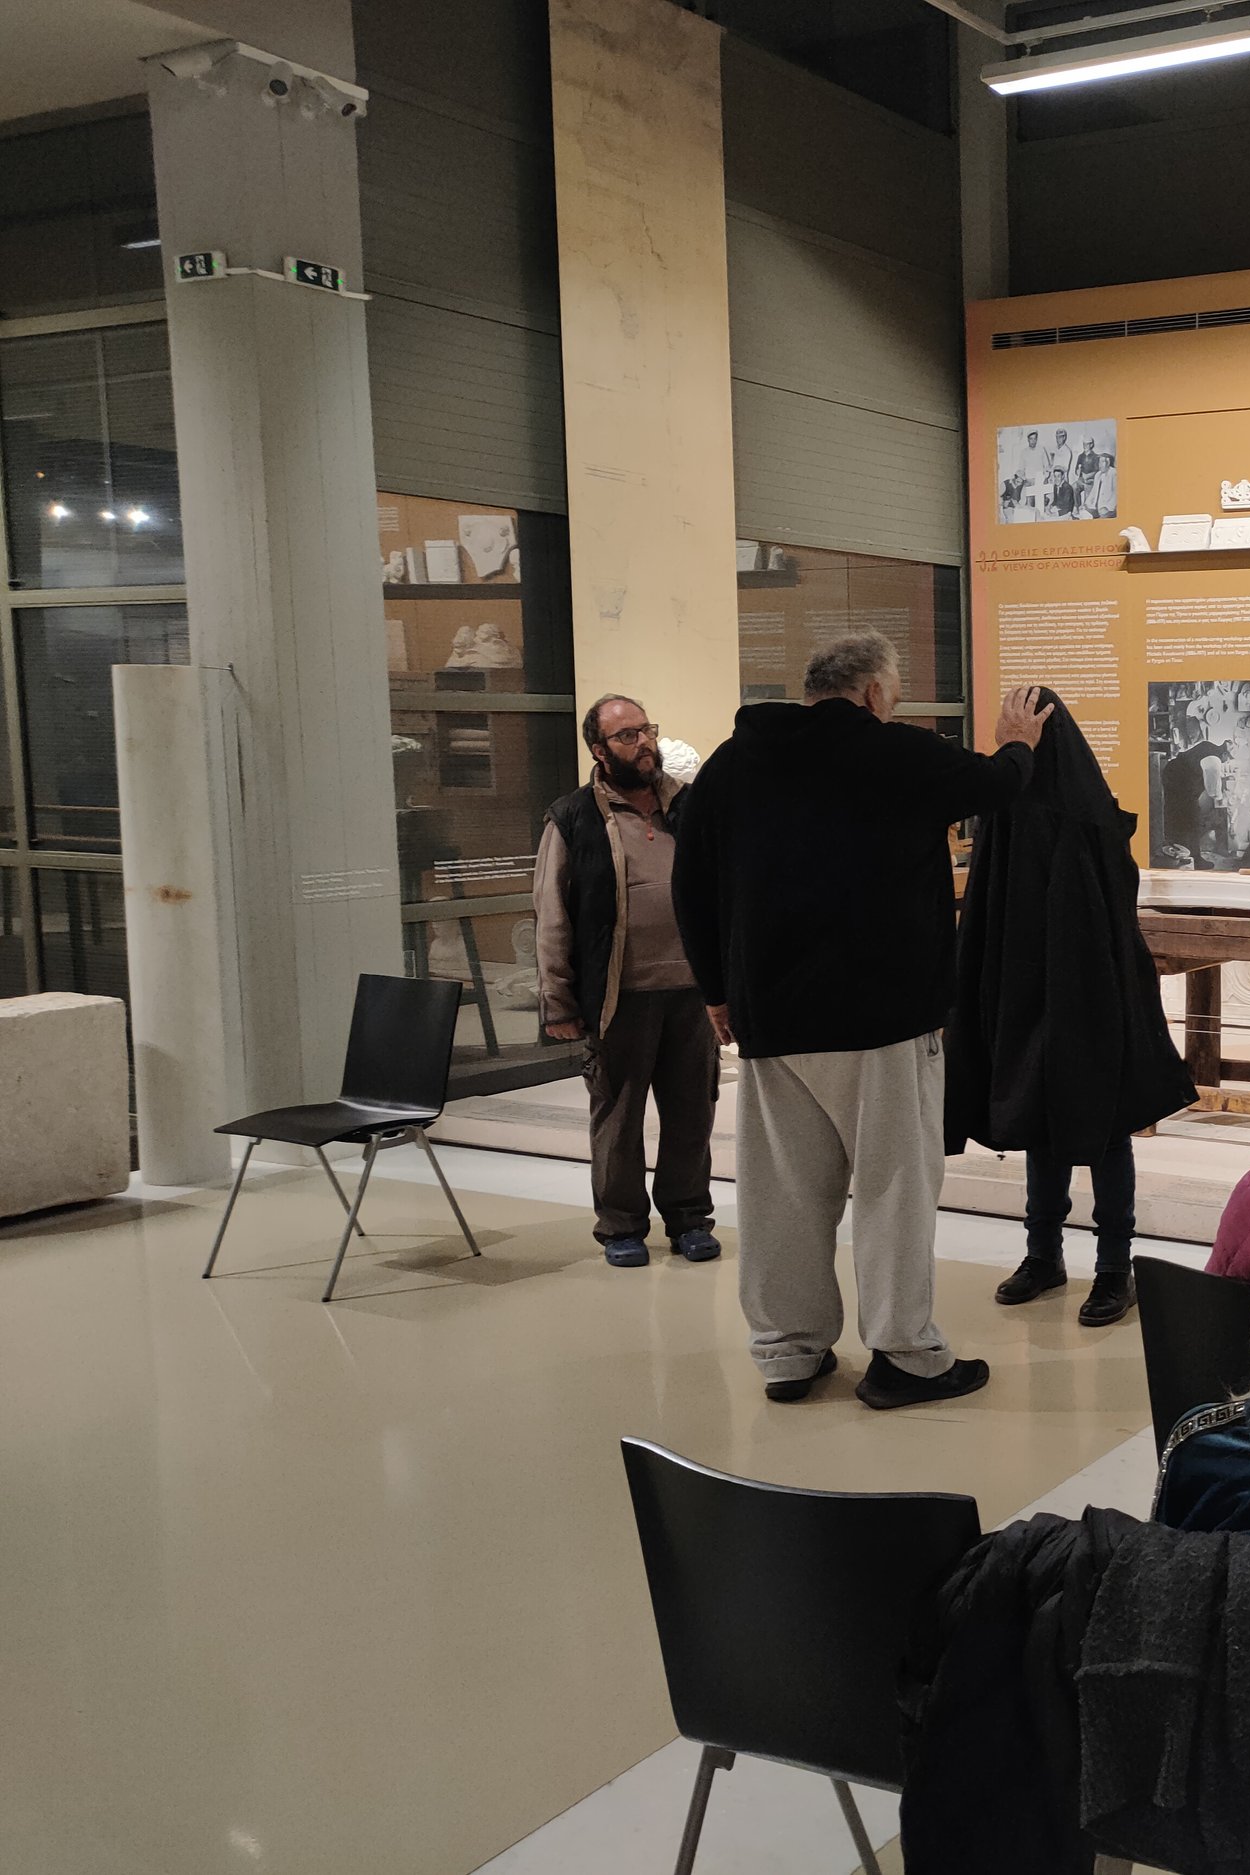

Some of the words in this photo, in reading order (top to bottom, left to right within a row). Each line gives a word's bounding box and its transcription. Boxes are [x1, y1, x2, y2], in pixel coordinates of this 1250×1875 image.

[1003, 548, 1038, 558] ΟΨΕΙΣ
[1043, 544, 1122, 556] ΕΡΓΑΣΤΗΡΙΟΥ
[1003, 562, 1035, 572] VIEWS
[1037, 561, 1051, 570] OF
[1052, 560, 1060, 569] A
[1061, 558, 1122, 569] WORKSHOP
